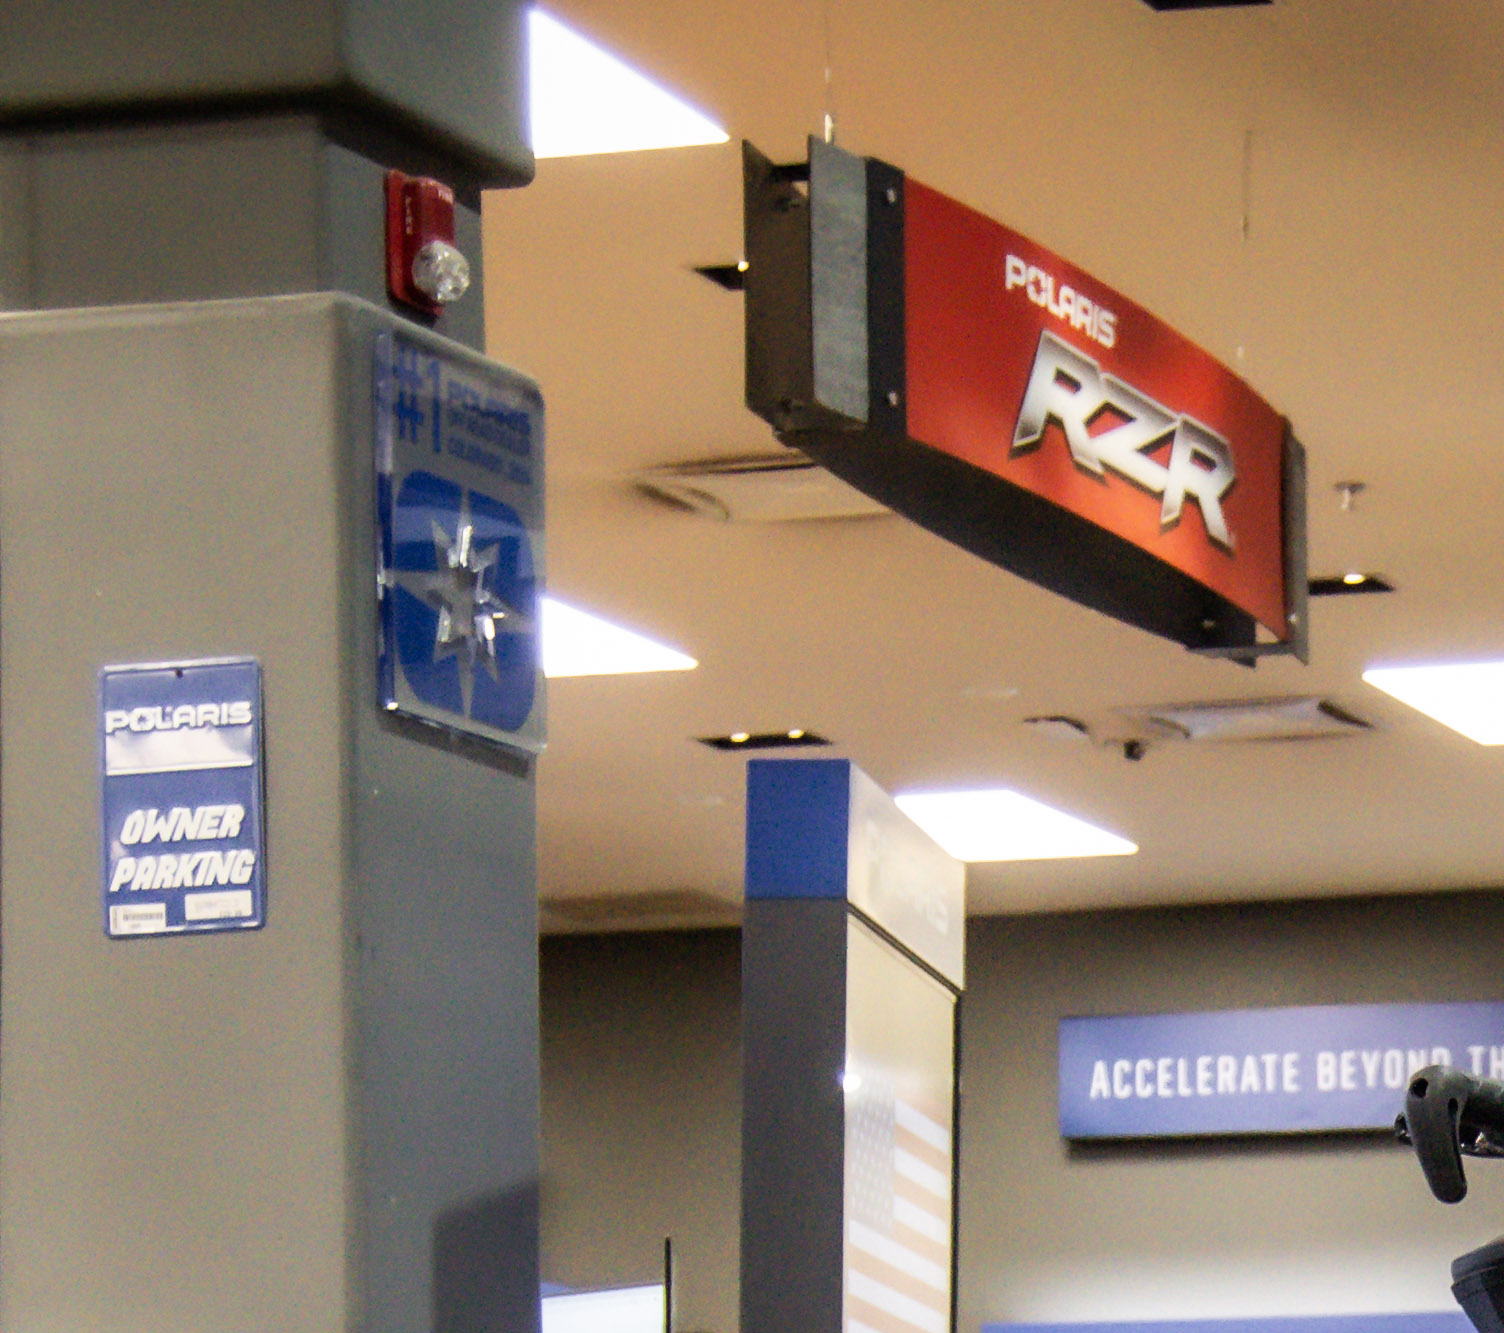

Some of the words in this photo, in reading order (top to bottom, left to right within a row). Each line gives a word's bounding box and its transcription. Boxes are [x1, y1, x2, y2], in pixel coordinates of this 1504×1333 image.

[1005, 254, 1117, 349] POLARIS
[1009, 328, 1237, 553] RZR
[105, 701, 253, 733] POLARIS
[120, 804, 245, 845] OWNER
[109, 849, 256, 892] PARKING
[1090, 1051, 1300, 1100] ACCELERATE
